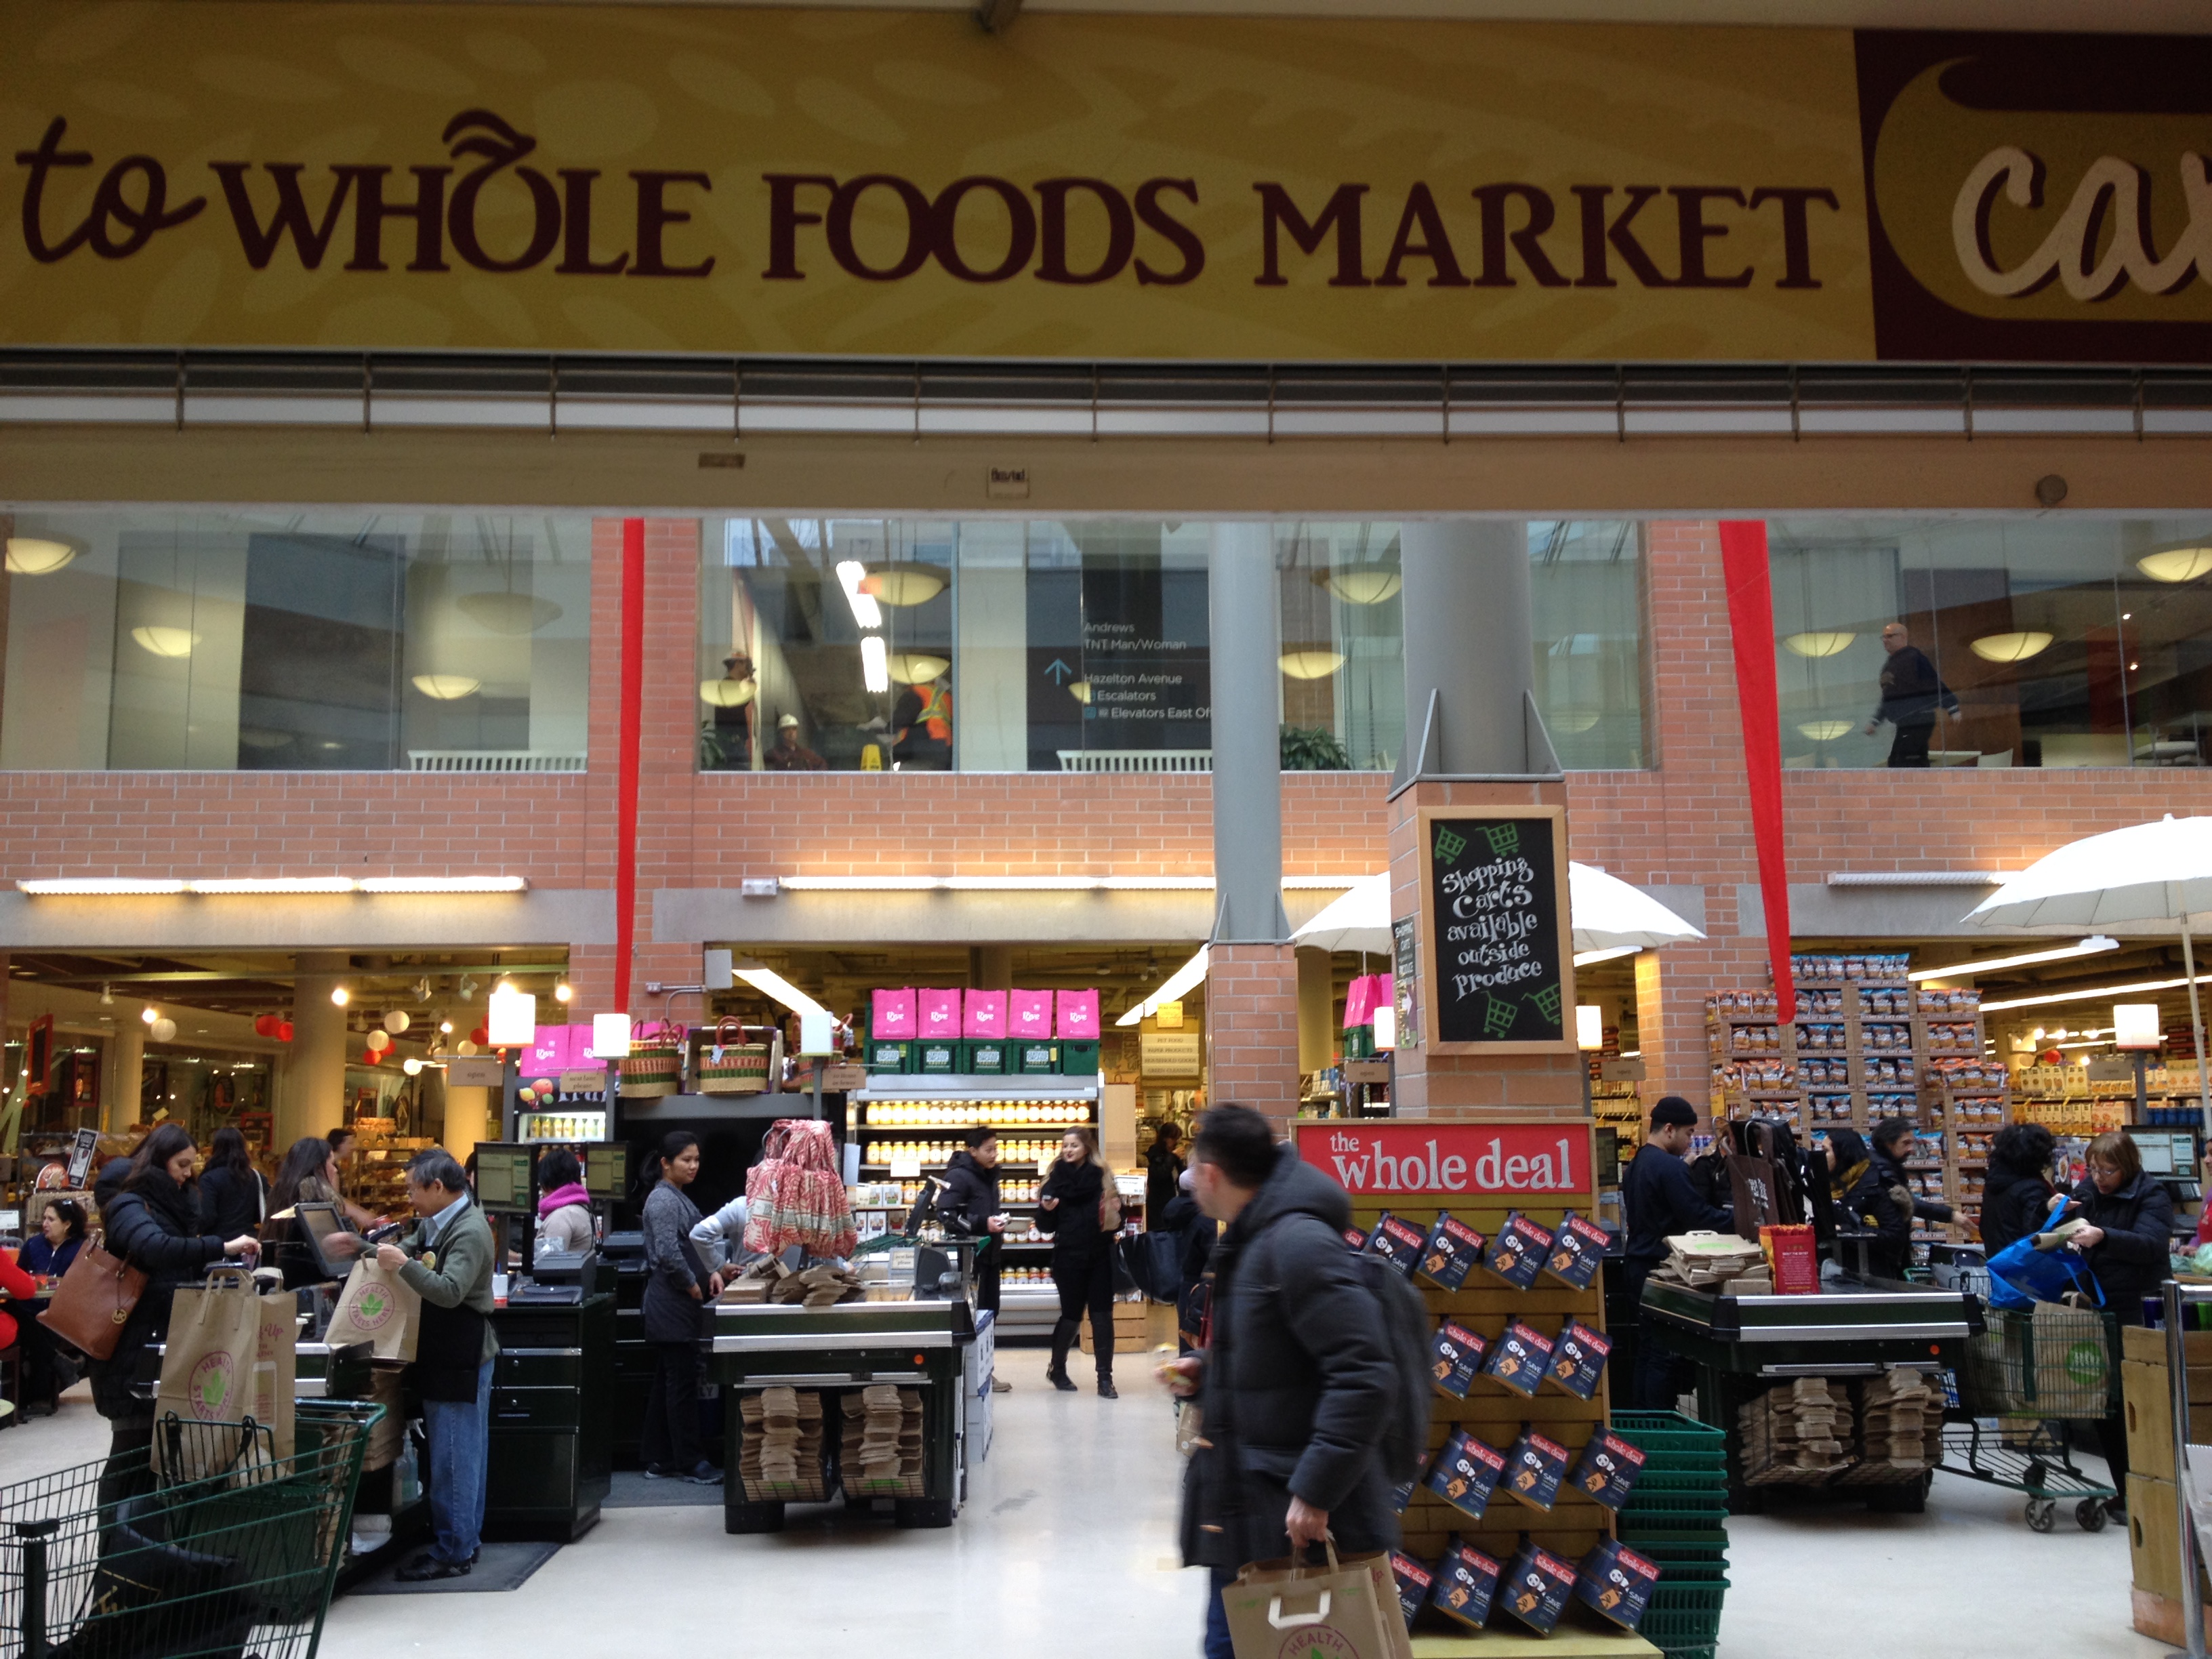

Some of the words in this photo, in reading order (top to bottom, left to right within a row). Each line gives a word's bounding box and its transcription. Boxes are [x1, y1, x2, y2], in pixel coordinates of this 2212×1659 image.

[15, 116, 207, 262] to
[208, 108, 716, 276] WHOLE
[761, 173, 1206, 286] FOODS
[1251, 180, 1841, 288] MARKET
[1084, 622, 1135, 634] Andrews
[1084, 639, 1108, 650] TNT
[1111, 638, 1187, 651] Man/Woman
[1084, 673, 1135, 685] Hazelton
[1139, 673, 1182, 685] Avenue
[1098, 690, 1157, 701] Escalators
[1111, 707, 1165, 719] Elevators
[1167, 708, 1192, 719] East
[1441, 857, 1534, 895] Shopping
[1447, 909, 1538, 942] available
[1458, 939, 1531, 966] outside
[1452, 960, 1543, 1002] produce
[1330, 1132, 1359, 1153] the
[1331, 1139, 1467, 1190] whole
[1475, 1138, 1575, 1190] deal
[1345, 1231, 1361, 1246] deal
[1404, 1233, 1421, 1248] deal
[1465, 1233, 1481, 1248] deal
[1533, 1231, 1550, 1246] deal
[1591, 1231, 1607, 1246] deal
[1393, 1257, 1409, 1270] SAVE
[1454, 1257, 1470, 1270] SAVE
[1523, 1256, 1539, 1269] SAVE
[1580, 1255, 1597, 1268] SAVE
[359, 1286, 389, 1298] HEALTH
[373, 1307, 390, 1326] HERE
[1467, 1338, 1483, 1352] deal
[1534, 1338, 1550, 1352] deal
[1591, 1338, 1607, 1355] deal
[201, 1357, 231, 1376] HEALTH
[1459, 1363, 1475, 1376] SAVE
[1526, 1361, 1542, 1373] SAVE
[1582, 1364, 1597, 1377] SAVE
[194, 1385, 214, 1420] STARTS
[1486, 1454, 1502, 1470] deal
[1551, 1448, 1567, 1462] deal
[1626, 1450, 1643, 1465] deal
[1544, 1473, 1559, 1486] SAVE
[1614, 1475, 1632, 1489] SAVE
[1475, 1481, 1492, 1495] SAVE
[1476, 1589, 1492, 1602] SAVE
[1629, 1591, 1647, 1605] SAVE
[1401, 1598, 1418, 1612] SAVE
[1546, 1596, 1563, 1610] SAVE
[1288, 1631, 1345, 1656] HEALTH
